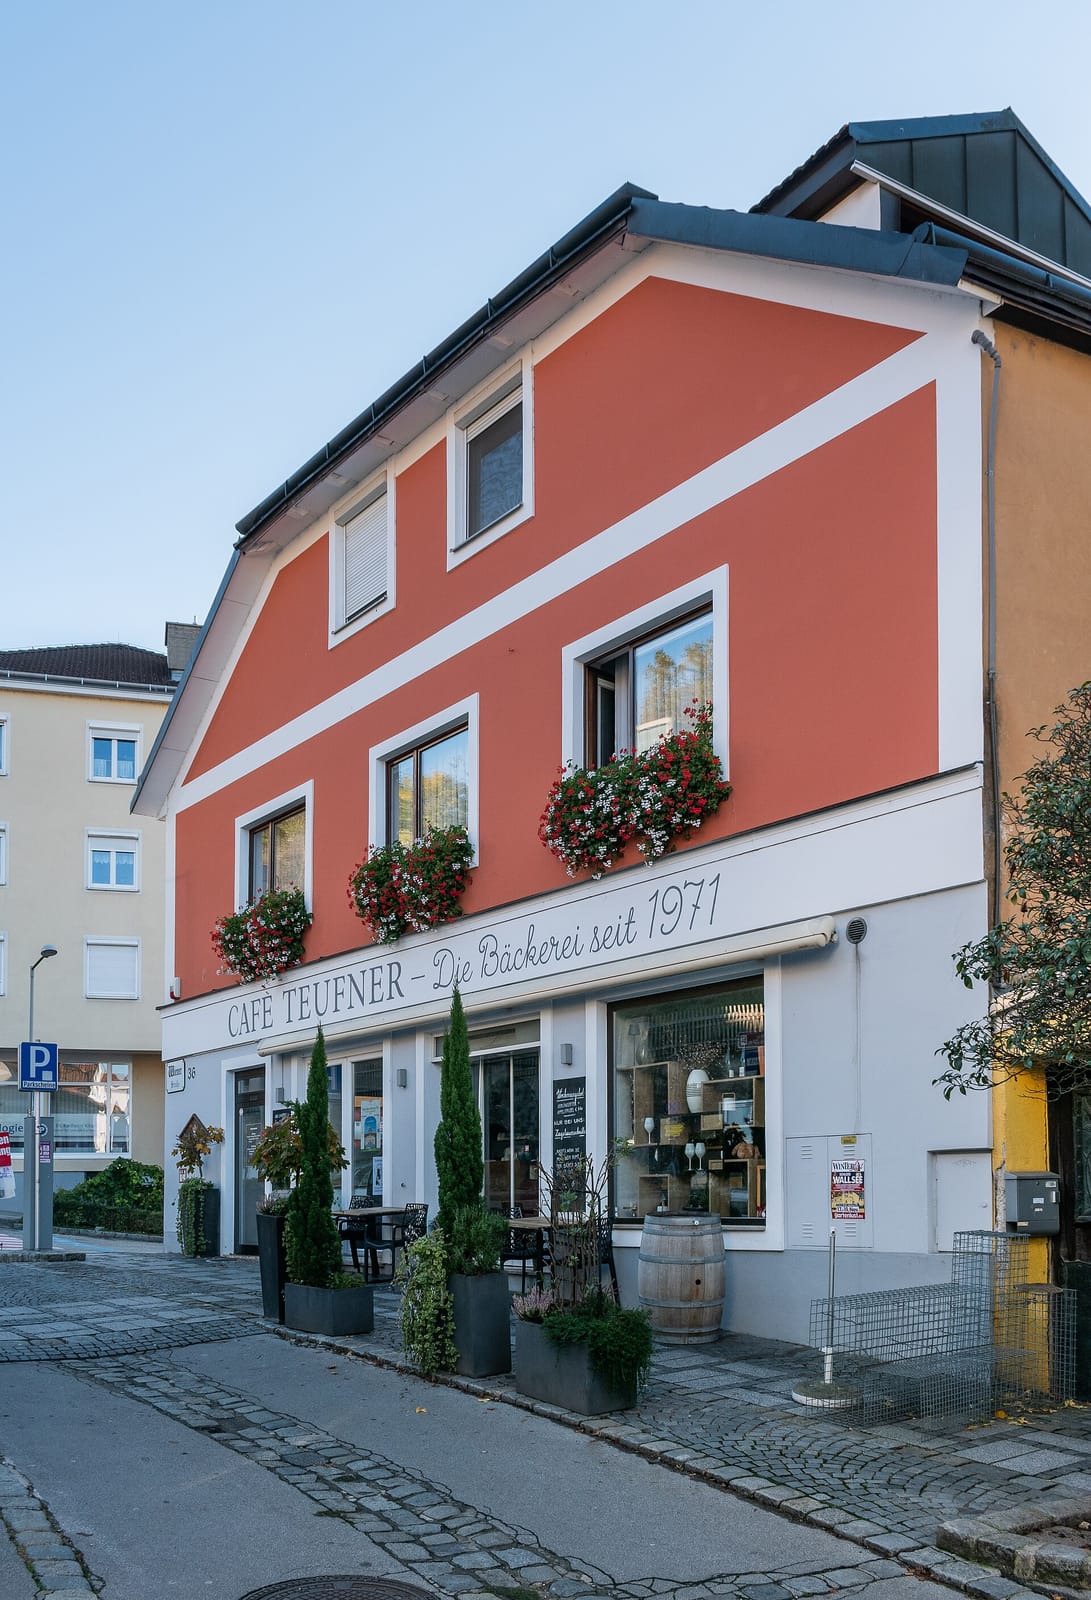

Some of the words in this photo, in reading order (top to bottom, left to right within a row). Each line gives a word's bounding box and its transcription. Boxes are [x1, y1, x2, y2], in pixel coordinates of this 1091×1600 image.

[282, 961, 405, 1024] TEUFNER
[432, 948, 473, 989] Die
[478, 923, 585, 978] Bäckerei
[589, 906, 638, 953] seit
[648, 873, 721, 939] 1971
[30, 1045, 51, 1079] P
[188, 1067, 196, 1080] 36
[832, 1175, 864, 1184] WALLSEE
